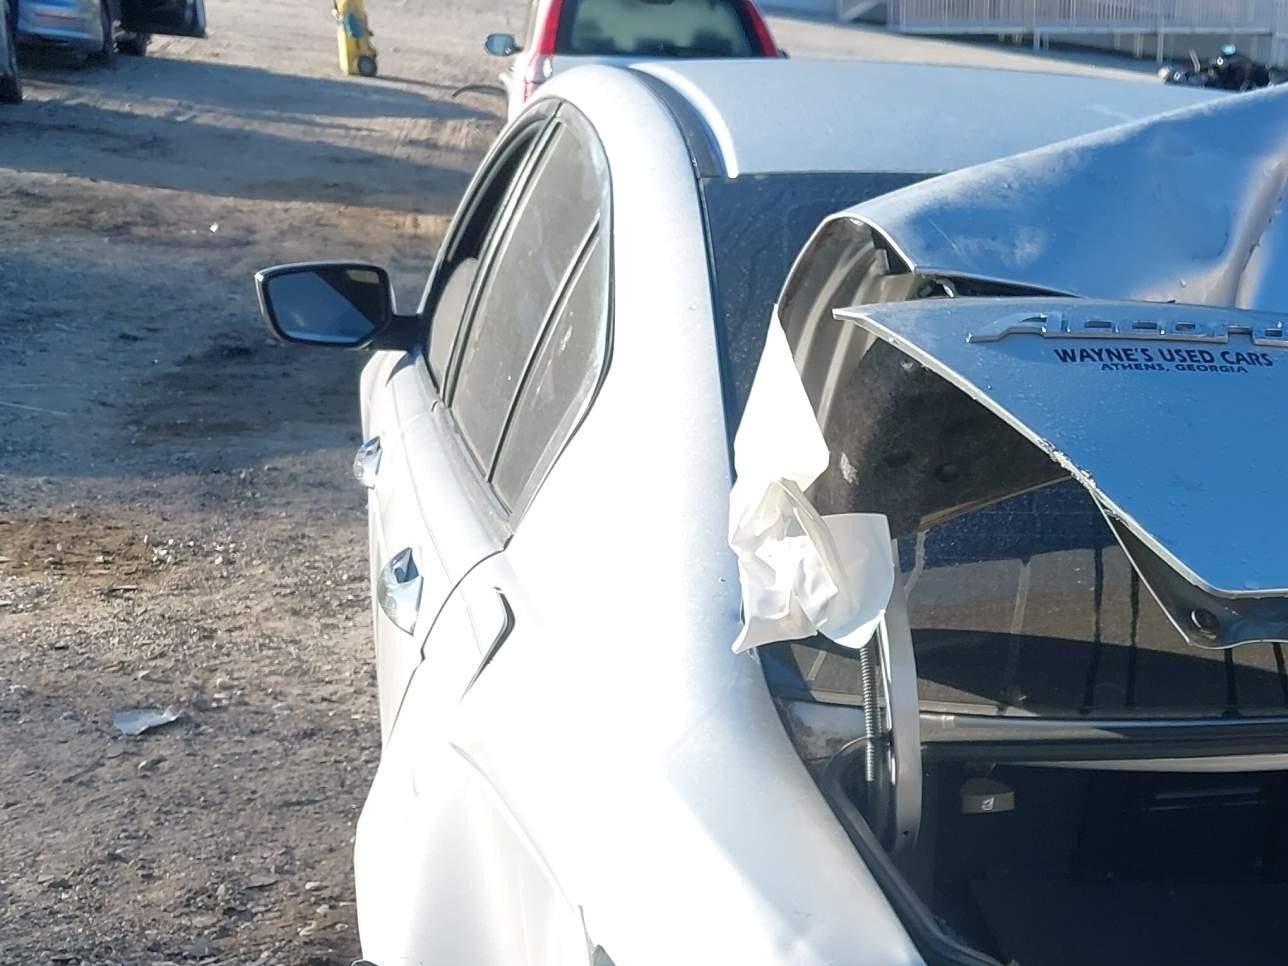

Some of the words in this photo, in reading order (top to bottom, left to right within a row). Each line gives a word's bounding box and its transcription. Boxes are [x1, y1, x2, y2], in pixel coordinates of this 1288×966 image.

[1054, 346, 1154, 363] WAYNE'S
[1161, 349, 1214, 365] USED
[1221, 350, 1274, 367] CARS
[1100, 362, 1170, 373] ATHENS,
[1174, 363, 1249, 374] GEORGIA
